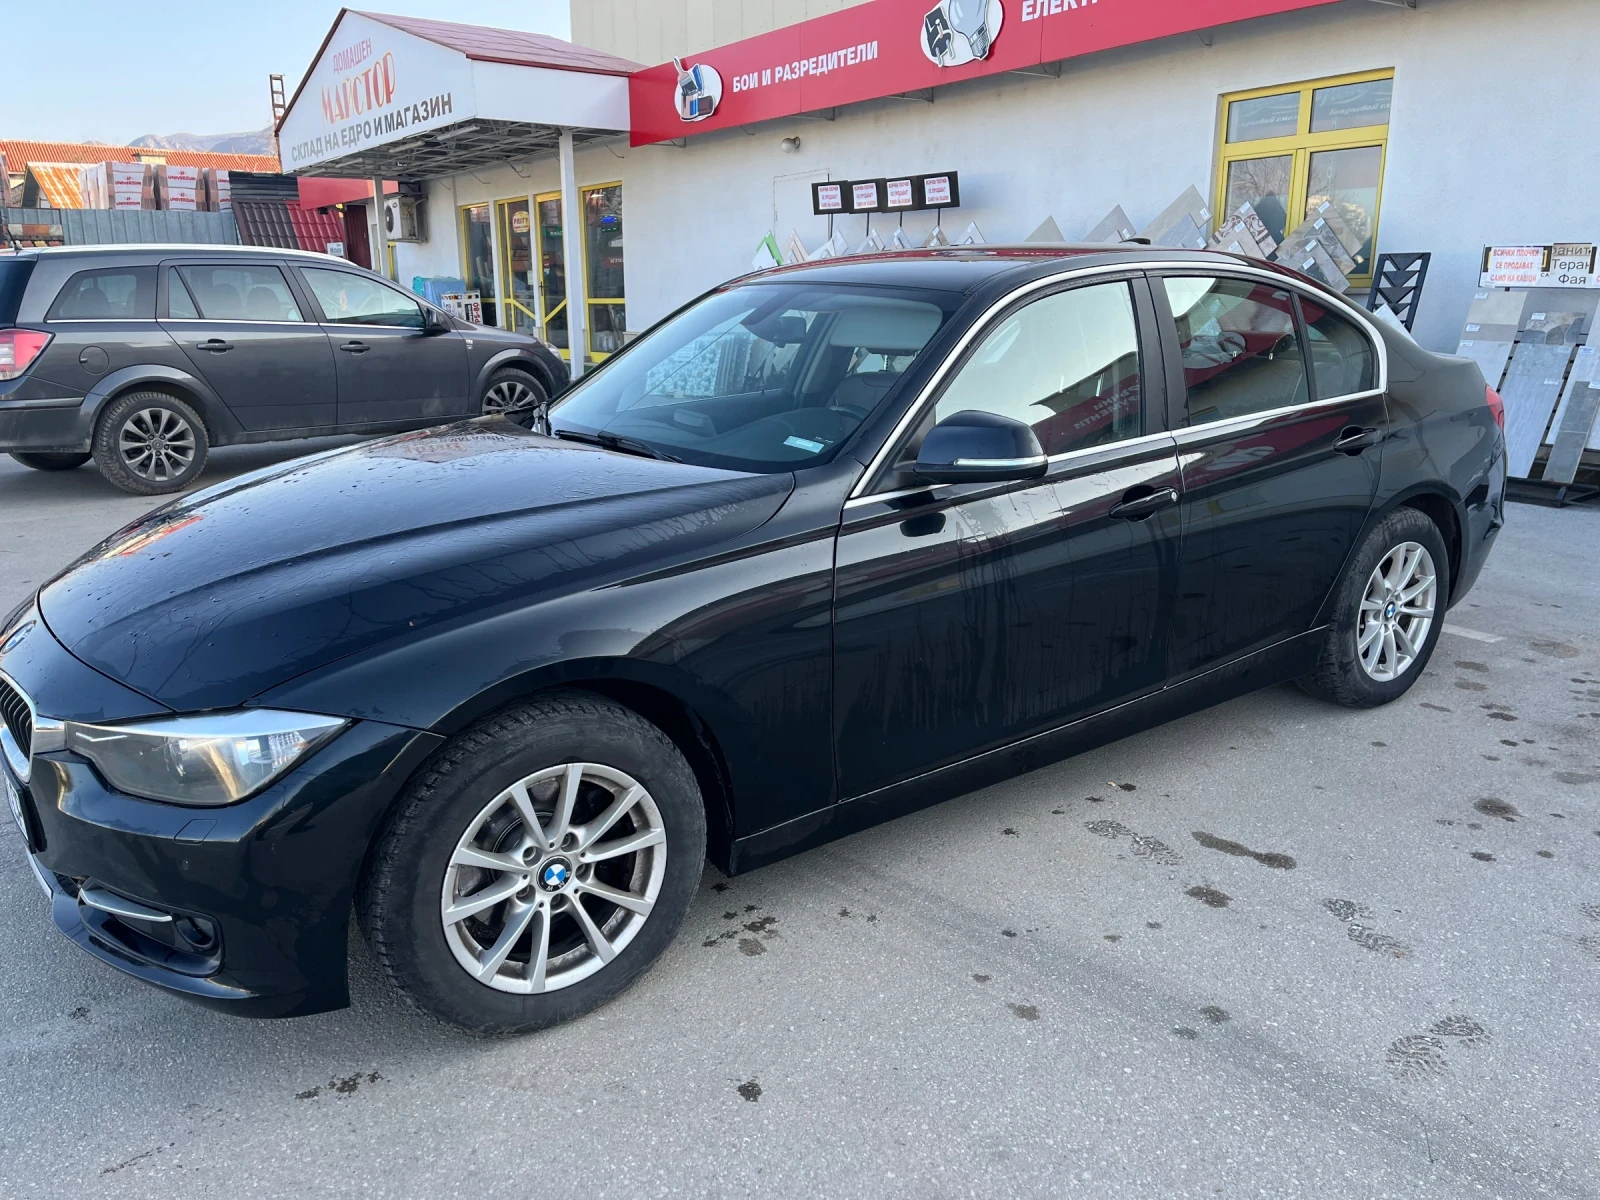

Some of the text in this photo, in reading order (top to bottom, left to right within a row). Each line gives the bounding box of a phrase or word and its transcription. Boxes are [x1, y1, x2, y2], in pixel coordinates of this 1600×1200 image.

[333, 38, 372, 74] ДОМАШЕН
[733, 40, 878, 92] БОИ И РАЗРЕДИТЕЛИ
[321, 51, 396, 126] МАЙСТОР
[291, 92, 453, 162] СКЛАД НА ЕДРО И МАГАЗИН
[1553, 246, 1591, 256] анит
